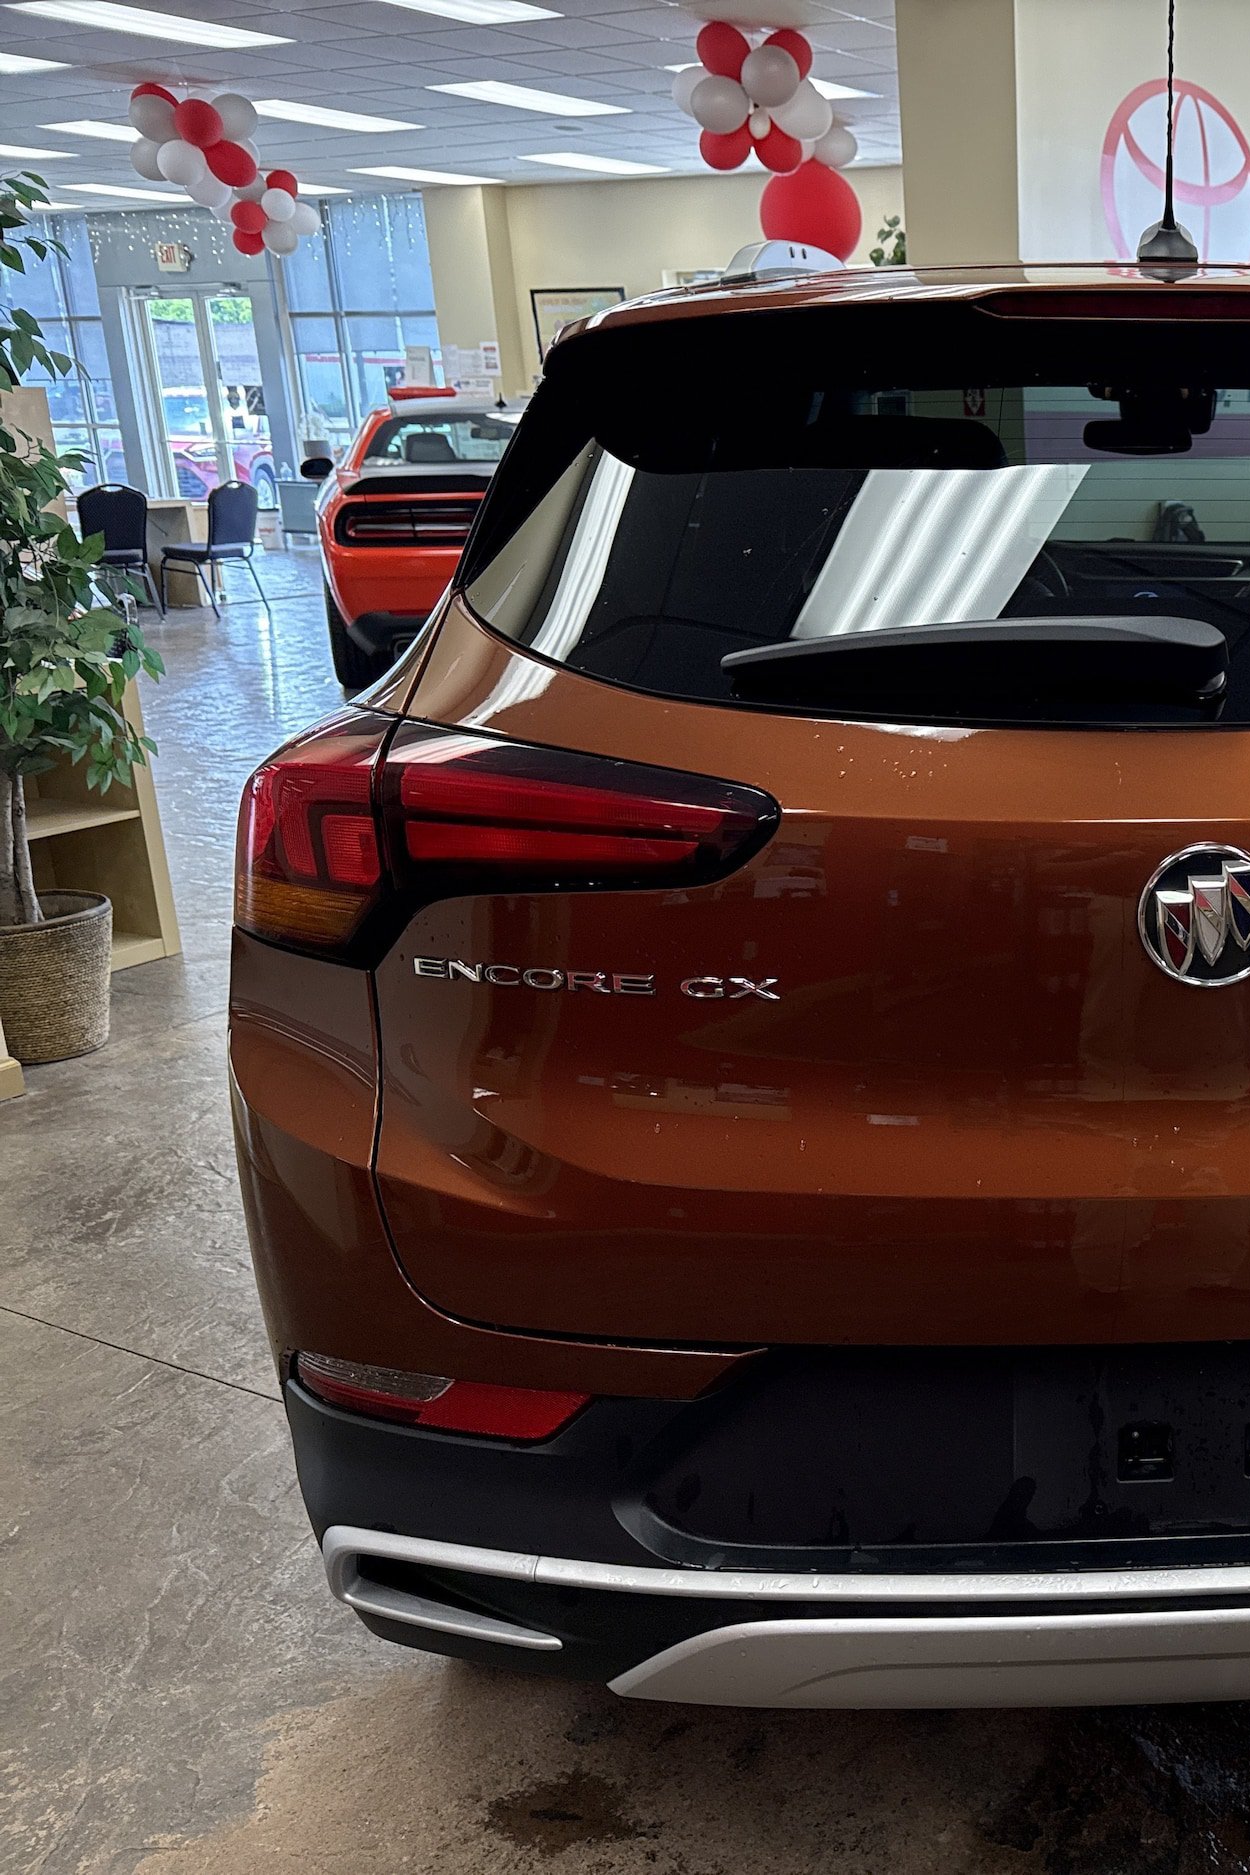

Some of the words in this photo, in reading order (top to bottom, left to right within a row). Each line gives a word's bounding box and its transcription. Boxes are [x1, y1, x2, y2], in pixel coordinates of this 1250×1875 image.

[159, 245, 177, 264] EXIT
[413, 955, 656, 995] ENCORE
[680, 975, 781, 1000] GX
